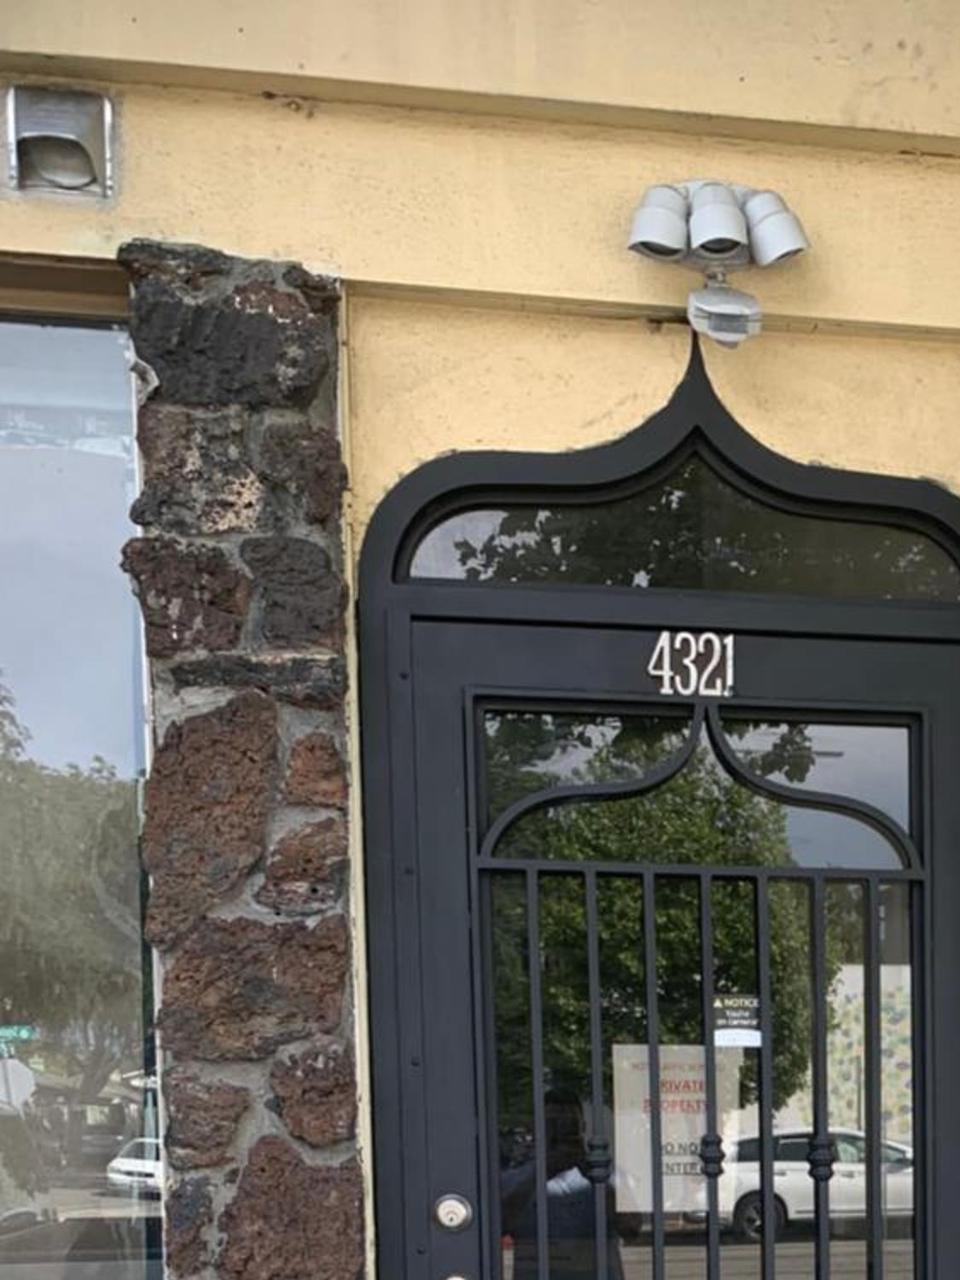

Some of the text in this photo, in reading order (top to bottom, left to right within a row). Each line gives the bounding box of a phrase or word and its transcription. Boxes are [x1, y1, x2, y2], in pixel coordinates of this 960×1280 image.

[647, 631, 734, 697] 4321
[657, 1079, 705, 1094] RIVATE
[663, 1161, 701, 1176] NTER
